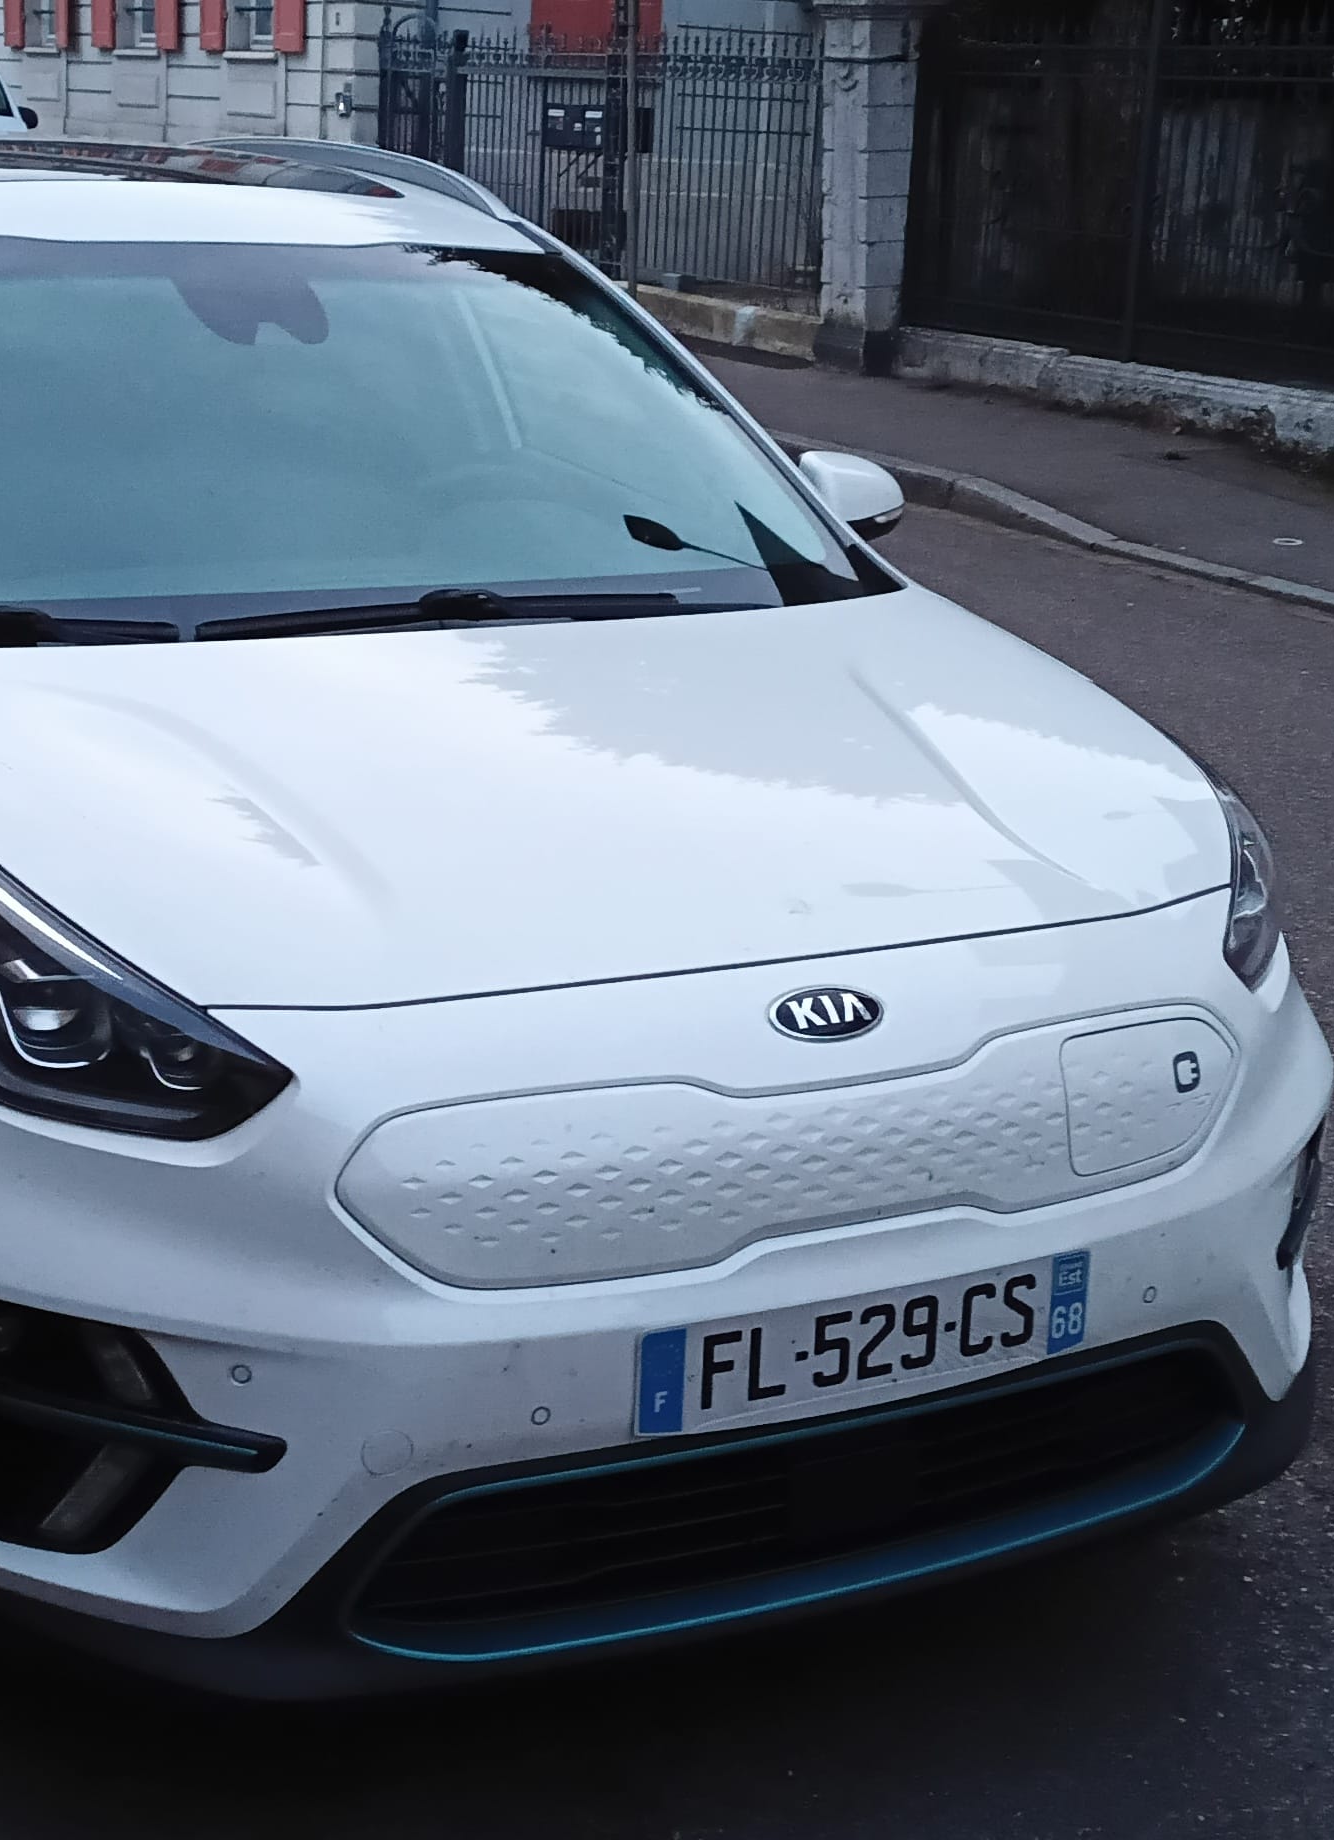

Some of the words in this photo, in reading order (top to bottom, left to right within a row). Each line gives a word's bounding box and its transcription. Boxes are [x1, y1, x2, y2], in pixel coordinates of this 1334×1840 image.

[787, 993, 871, 1030] KIA
[1058, 1268, 1083, 1287] Est
[1051, 1302, 1083, 1339] 68
[700, 1274, 1037, 1410] FL-529-CS
[654, 1391, 668, 1413] F
